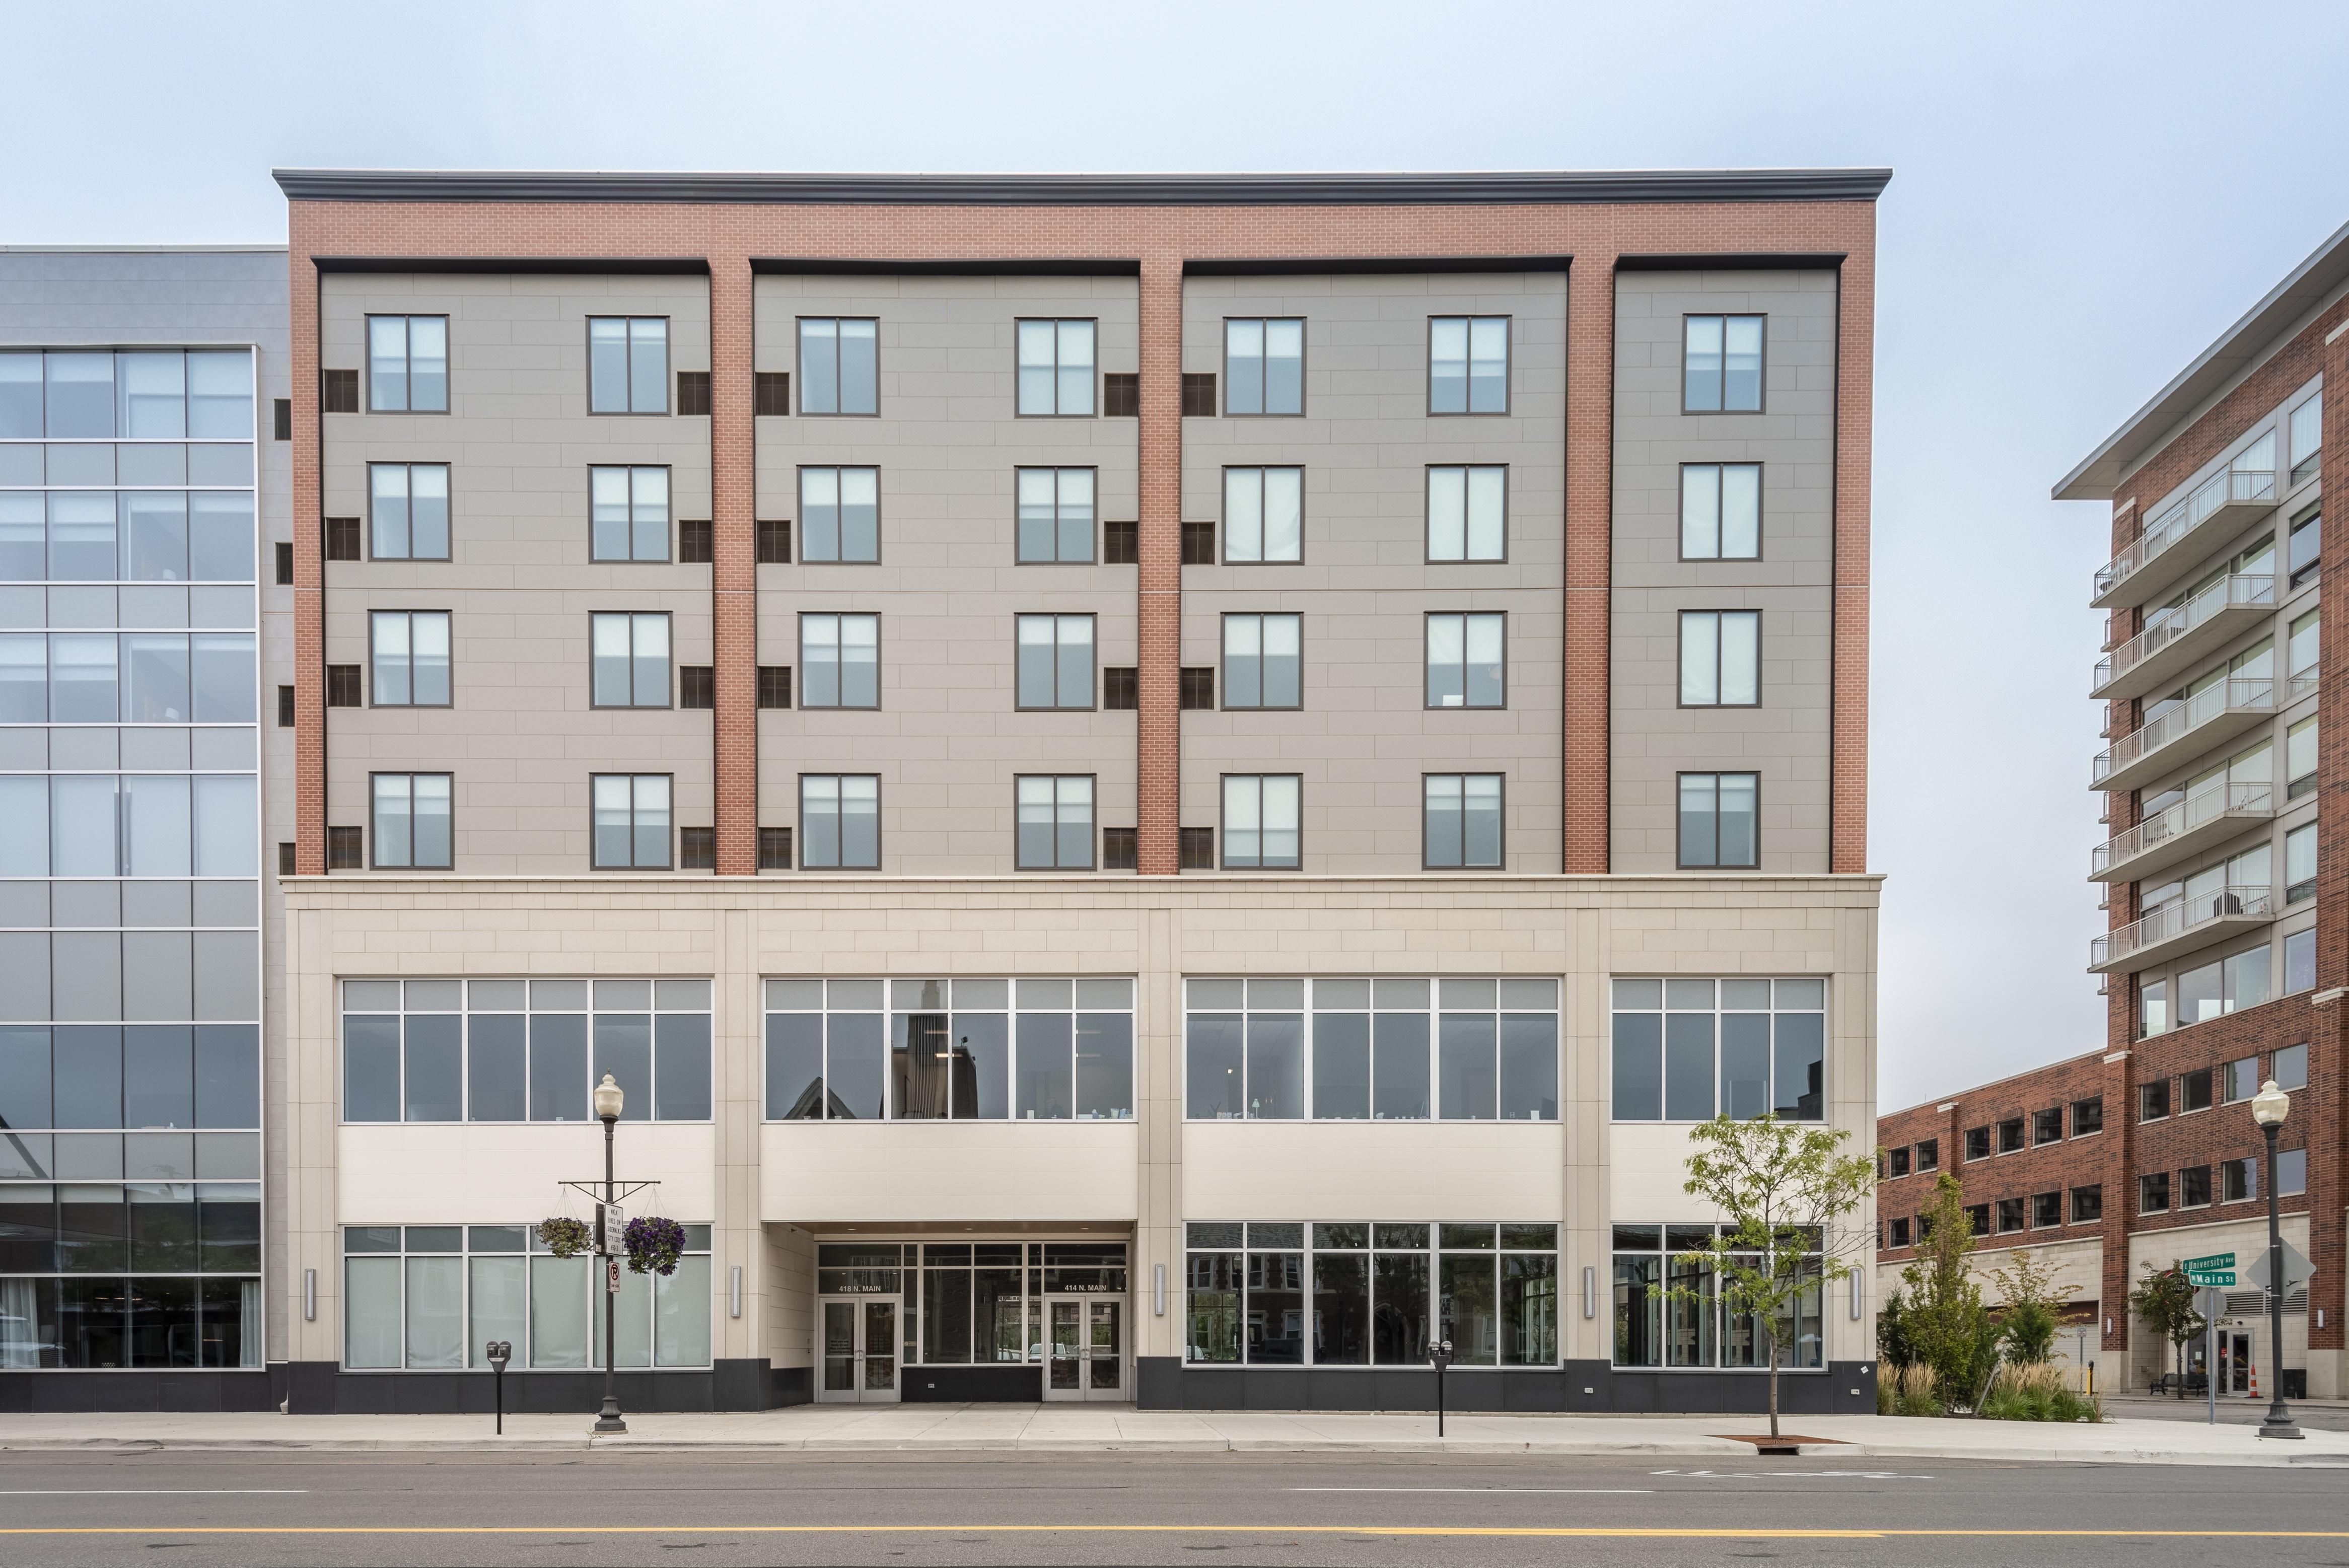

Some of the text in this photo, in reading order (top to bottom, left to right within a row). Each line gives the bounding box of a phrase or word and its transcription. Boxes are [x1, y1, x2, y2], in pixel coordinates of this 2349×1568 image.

[607, 1226, 621, 1235] SIDEWALKS
[2189, 1257, 2224, 1270] University
[2196, 1274, 2223, 1283] Main
